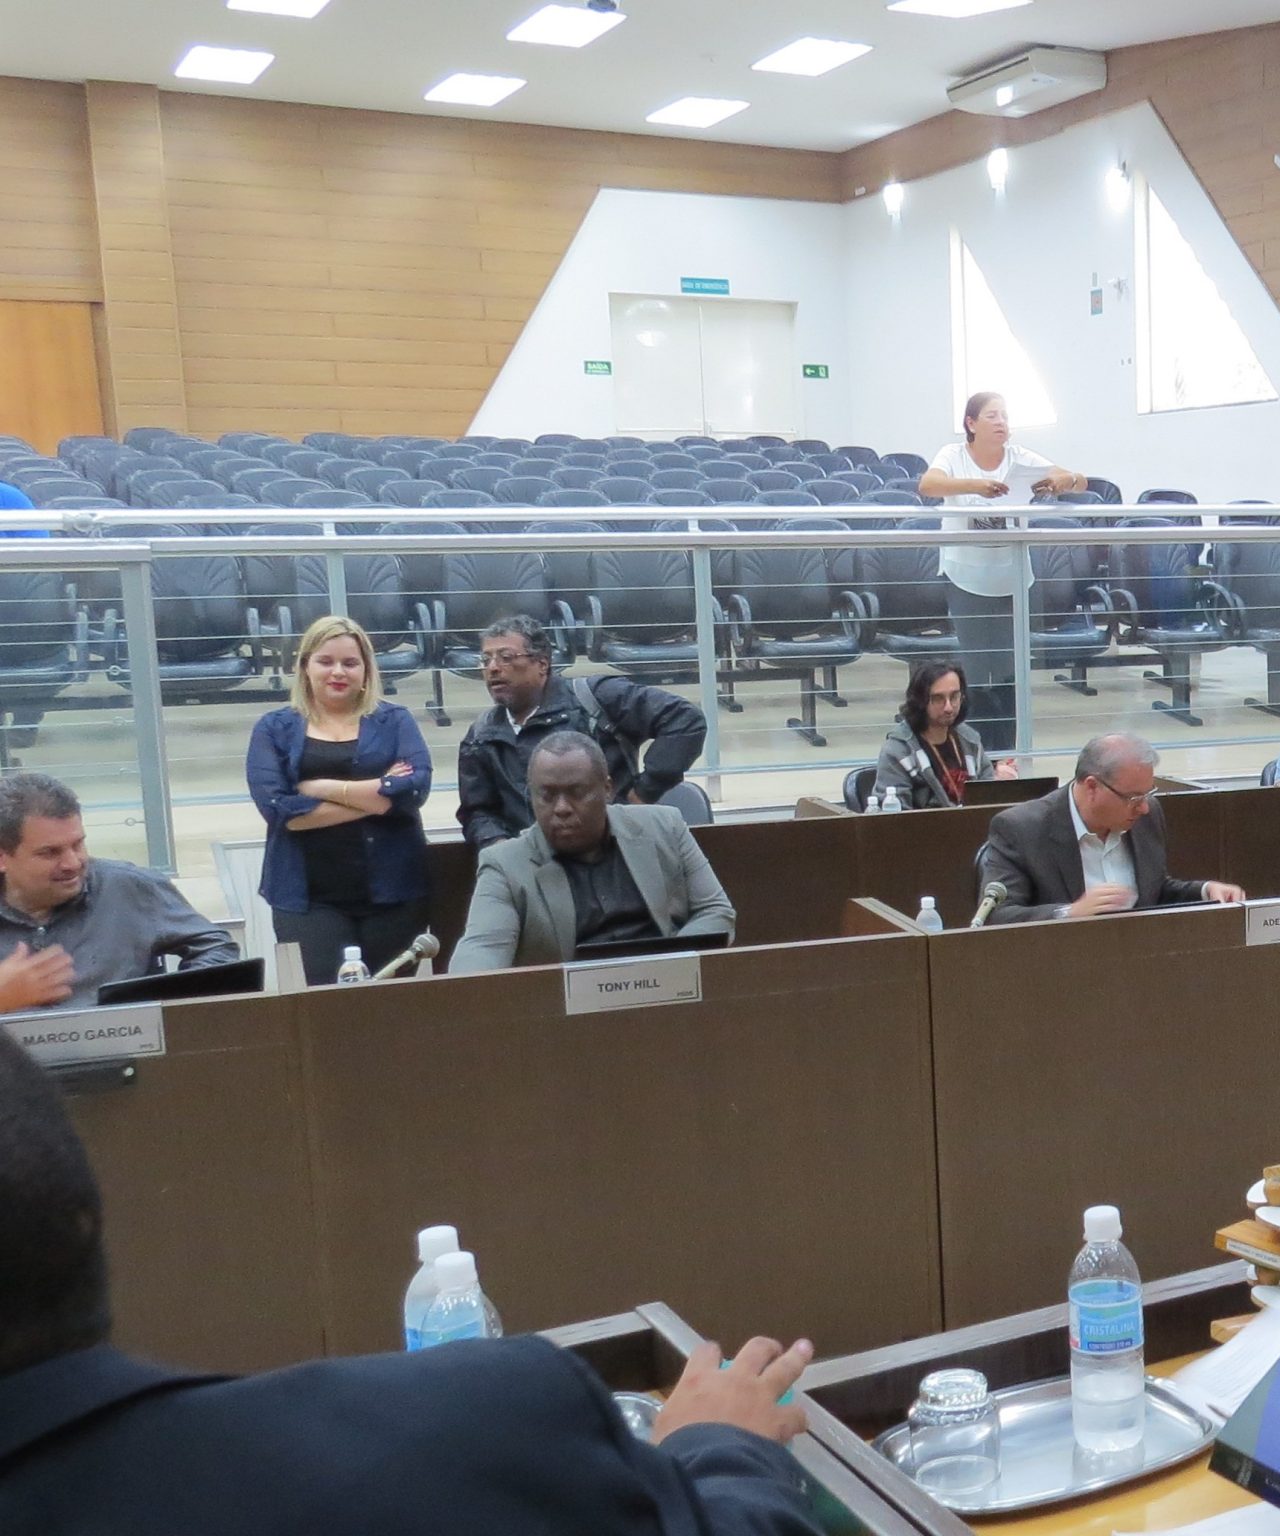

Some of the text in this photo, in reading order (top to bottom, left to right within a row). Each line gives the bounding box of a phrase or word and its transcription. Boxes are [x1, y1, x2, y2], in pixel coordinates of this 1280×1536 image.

[598, 979, 661, 993] TONY HILL
[23, 1024, 143, 1046] MARCO GARCIA
[1084, 1320, 1136, 1336] CRISTALINA
